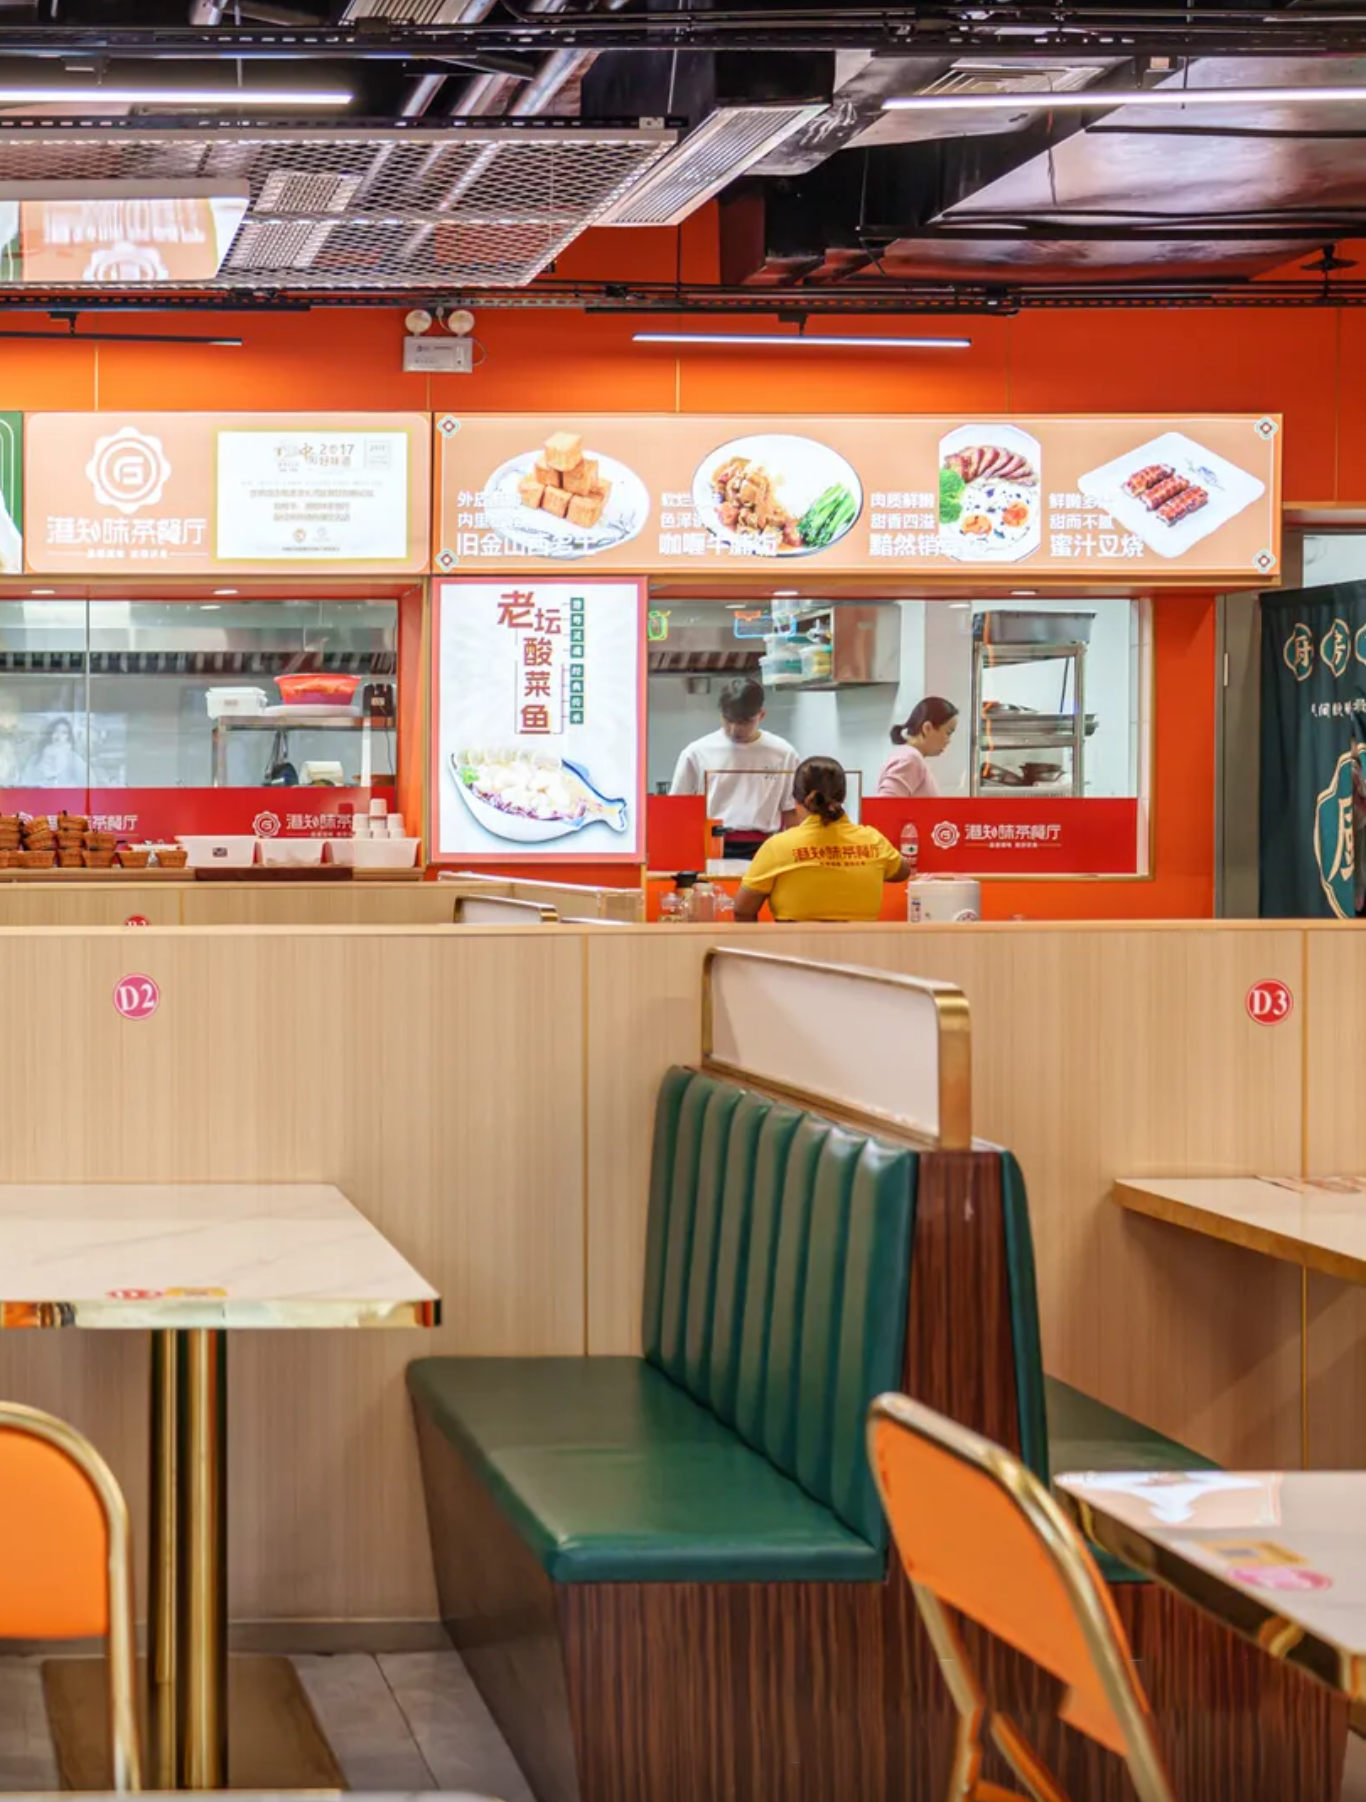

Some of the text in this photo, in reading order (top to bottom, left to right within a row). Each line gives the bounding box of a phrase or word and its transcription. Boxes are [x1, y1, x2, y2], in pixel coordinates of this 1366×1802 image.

[46, 517, 206, 545] 港知味茶餐厅
[870, 513, 935, 529] 甜香四溢
[1049, 532, 1145, 558] 蜜汁叉烧
[497, 591, 562, 735] 老坛酸菜鱼
[964, 823, 1062, 840] 港知味茶餐厅
[119, 983, 155, 1011] D2
[1252, 988, 1288, 1016] D3
